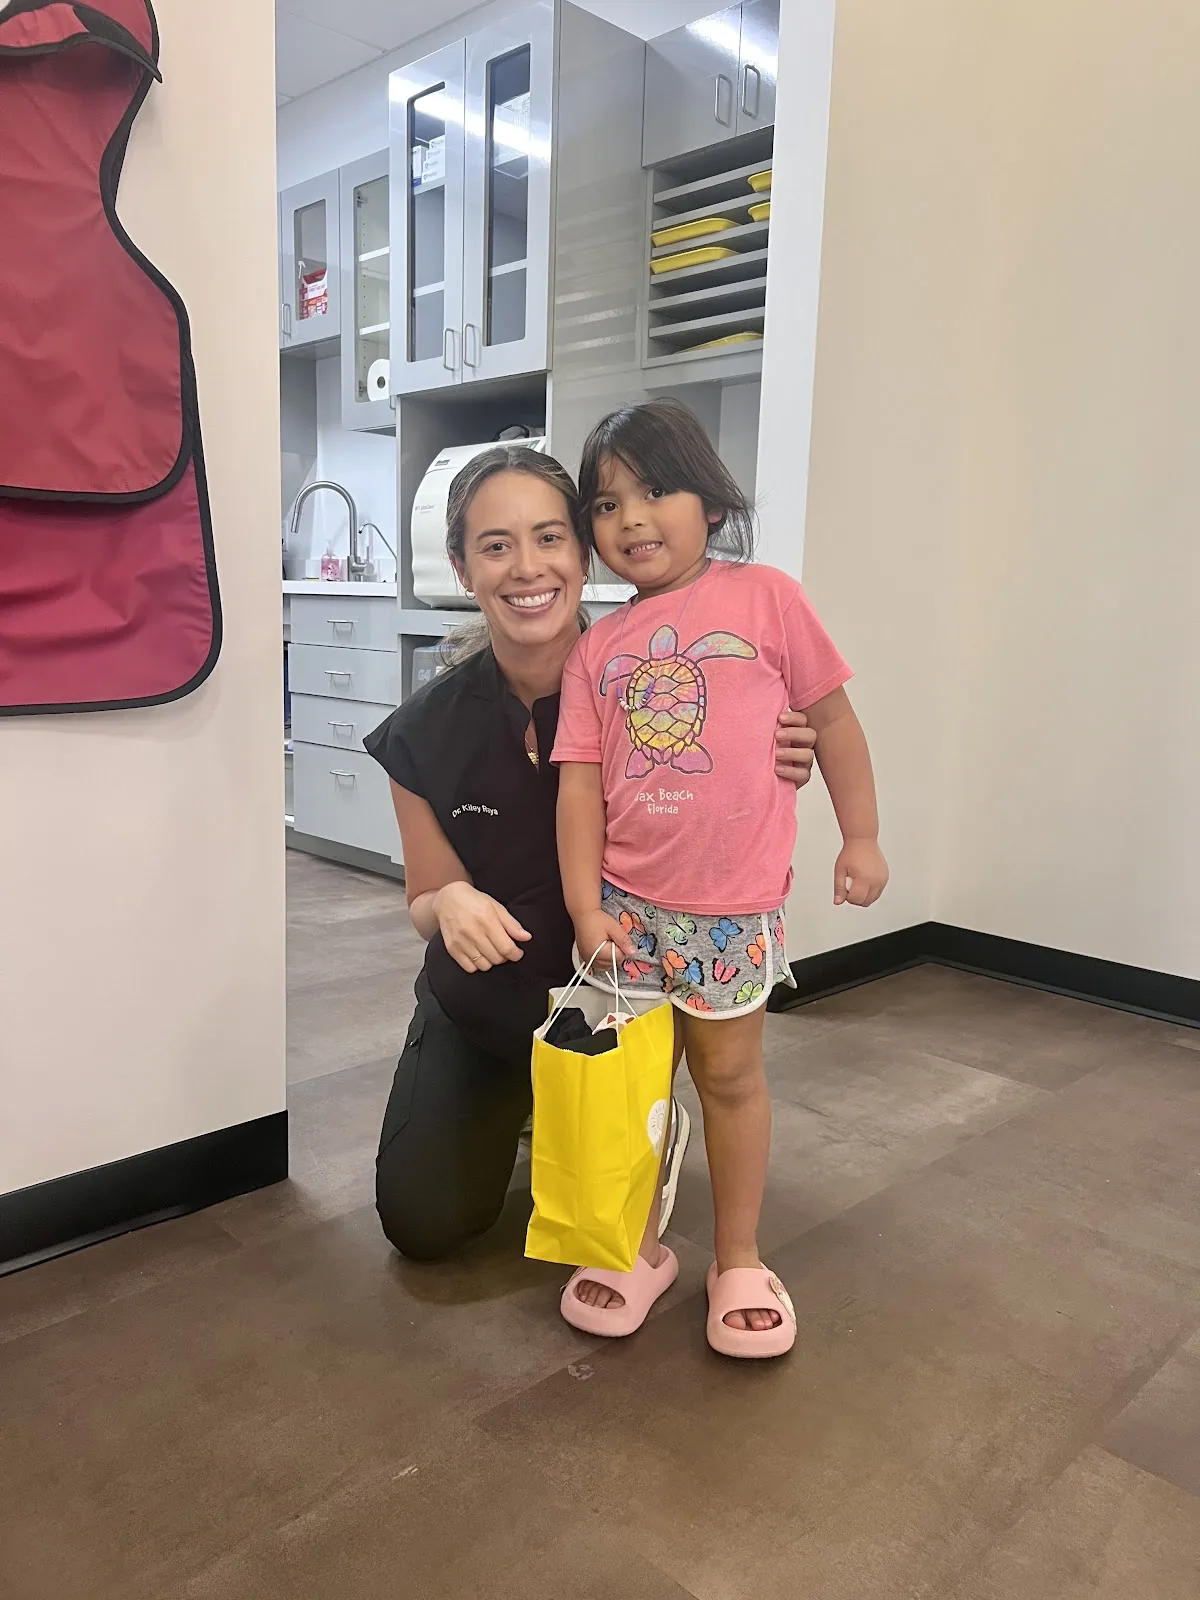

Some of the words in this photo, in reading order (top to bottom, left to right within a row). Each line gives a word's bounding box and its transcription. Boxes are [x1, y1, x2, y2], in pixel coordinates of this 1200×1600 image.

[659, 788, 694, 801] Beach
[462, 803, 481, 814] Kiley
[647, 803, 679, 814] Florida
